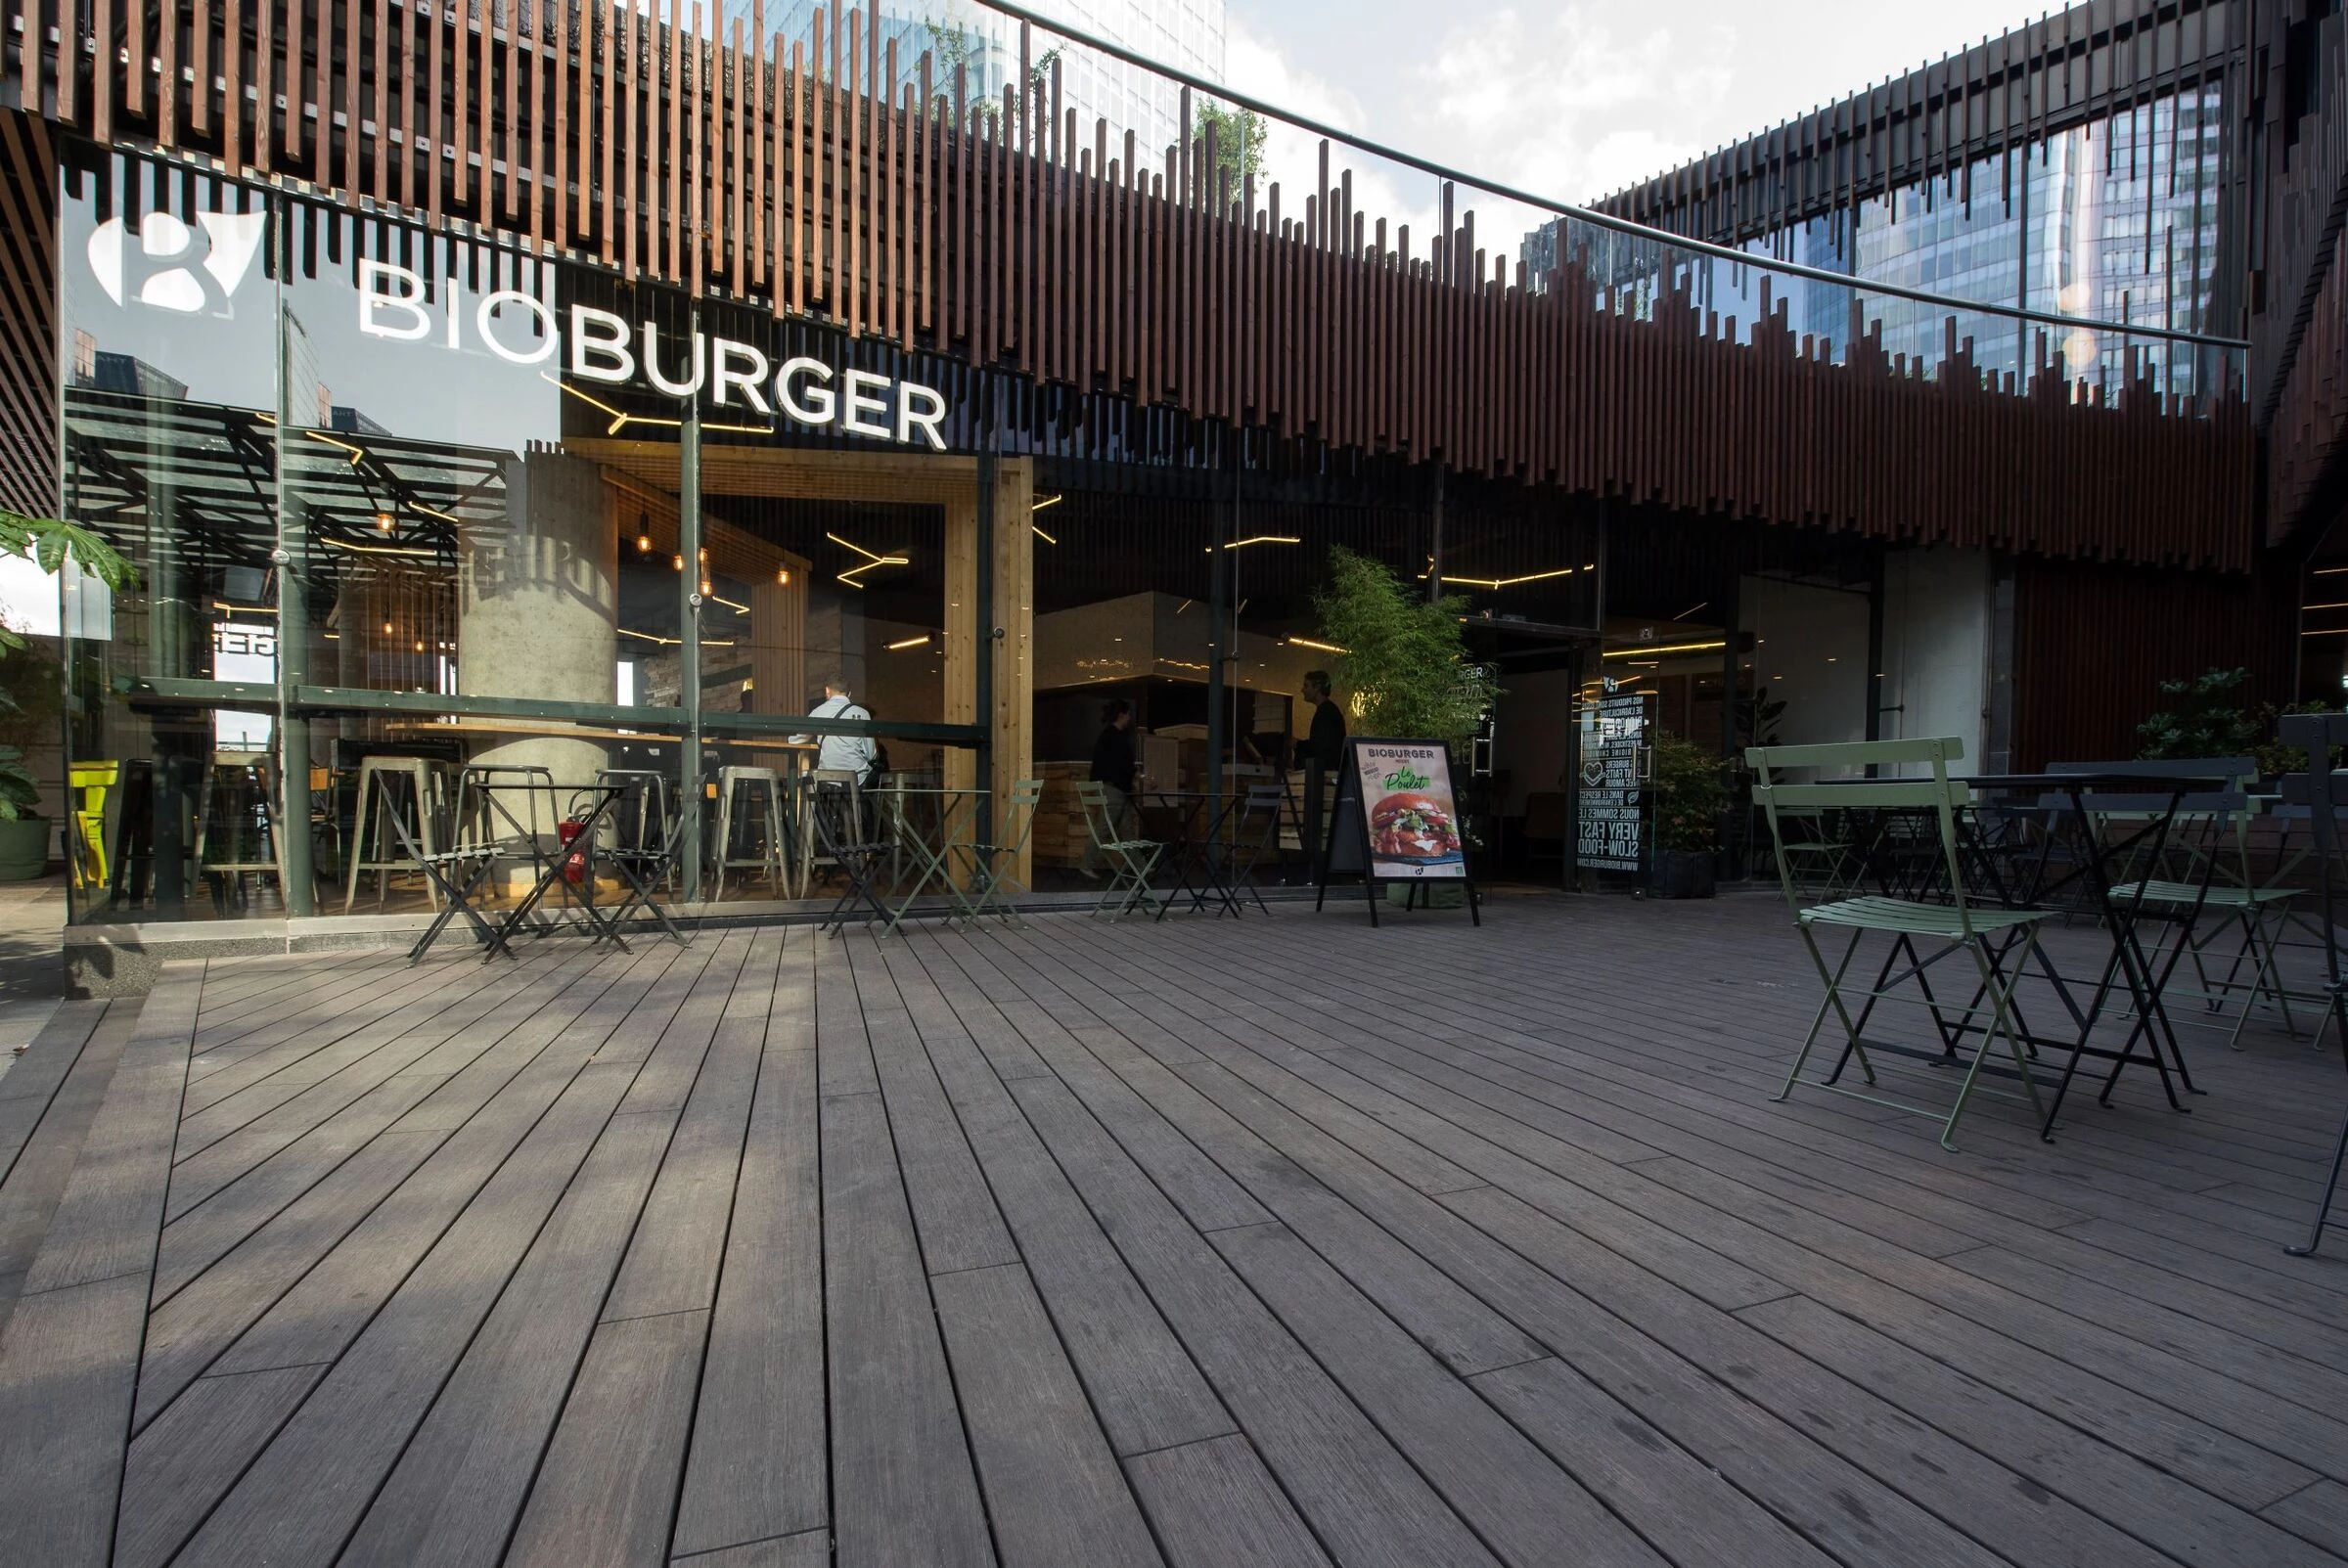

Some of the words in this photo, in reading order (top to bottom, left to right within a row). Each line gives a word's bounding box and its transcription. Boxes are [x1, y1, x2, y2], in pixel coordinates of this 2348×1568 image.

[358, 257, 948, 452] BIOBURGER
[1368, 747, 1435, 760] BIOBURGER
[1384, 772, 1430, 790] Poulet
